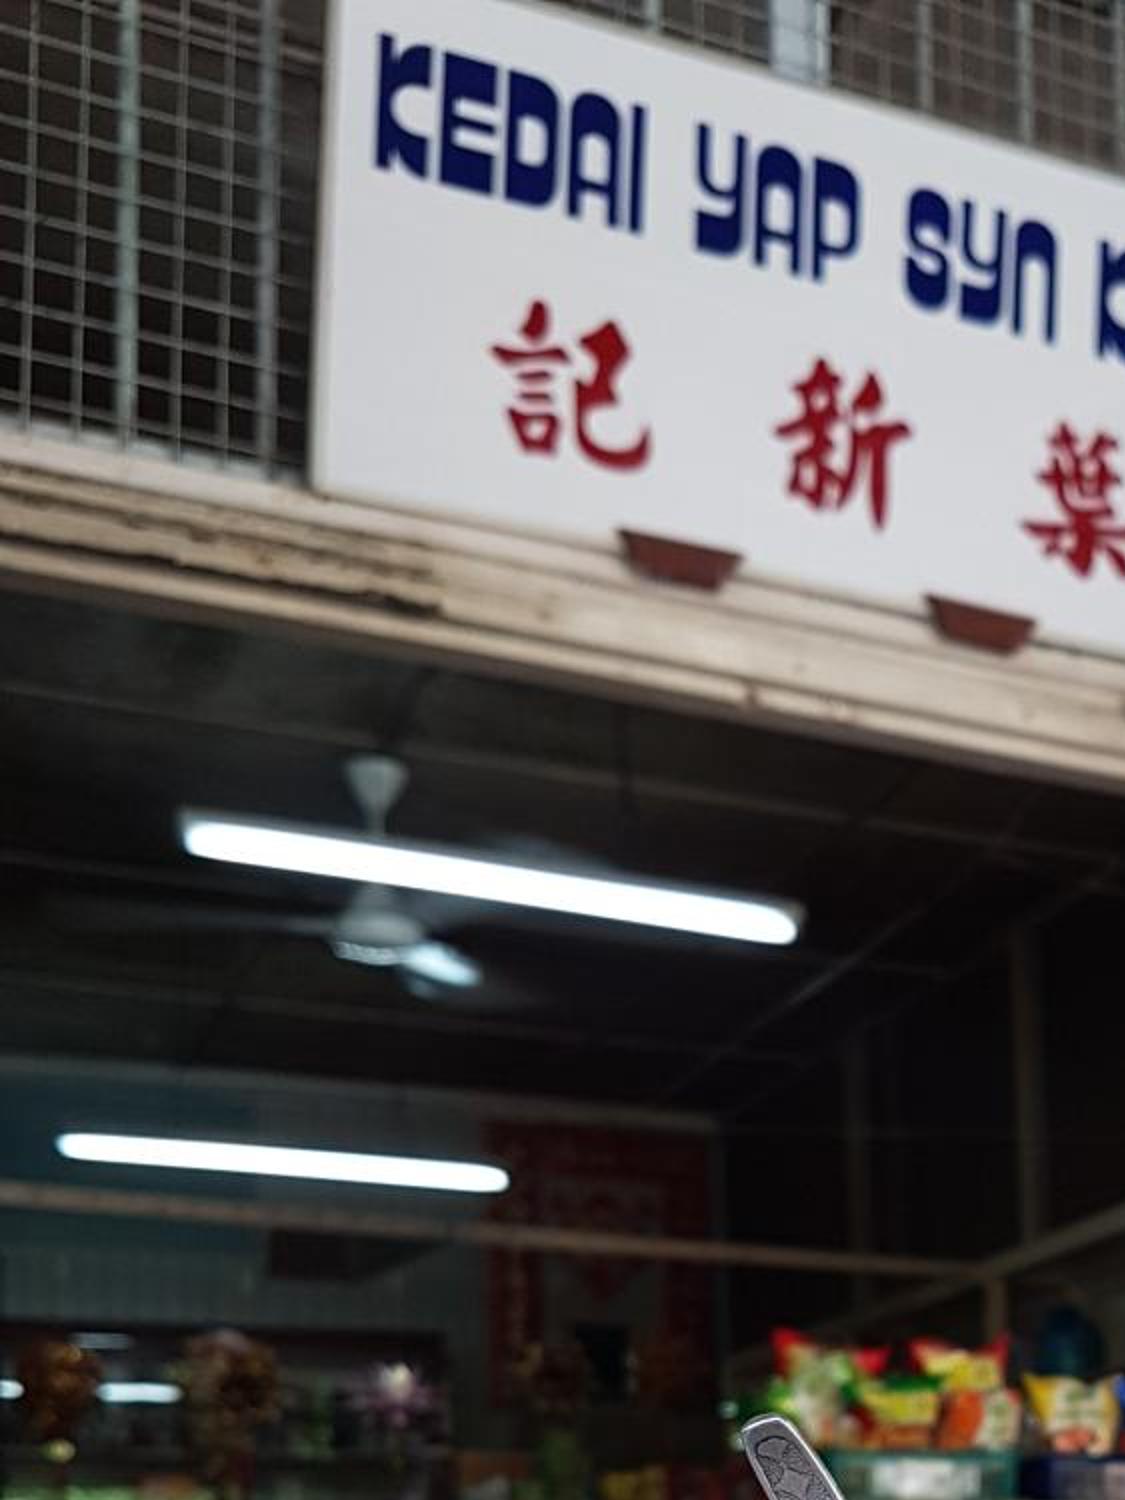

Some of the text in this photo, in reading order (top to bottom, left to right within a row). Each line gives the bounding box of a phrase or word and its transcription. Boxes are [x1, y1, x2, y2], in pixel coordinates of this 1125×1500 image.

[376, 33, 647, 234] KEDAI
[694, 122, 862, 282] YAP
[904, 187, 1058, 345] SYN
